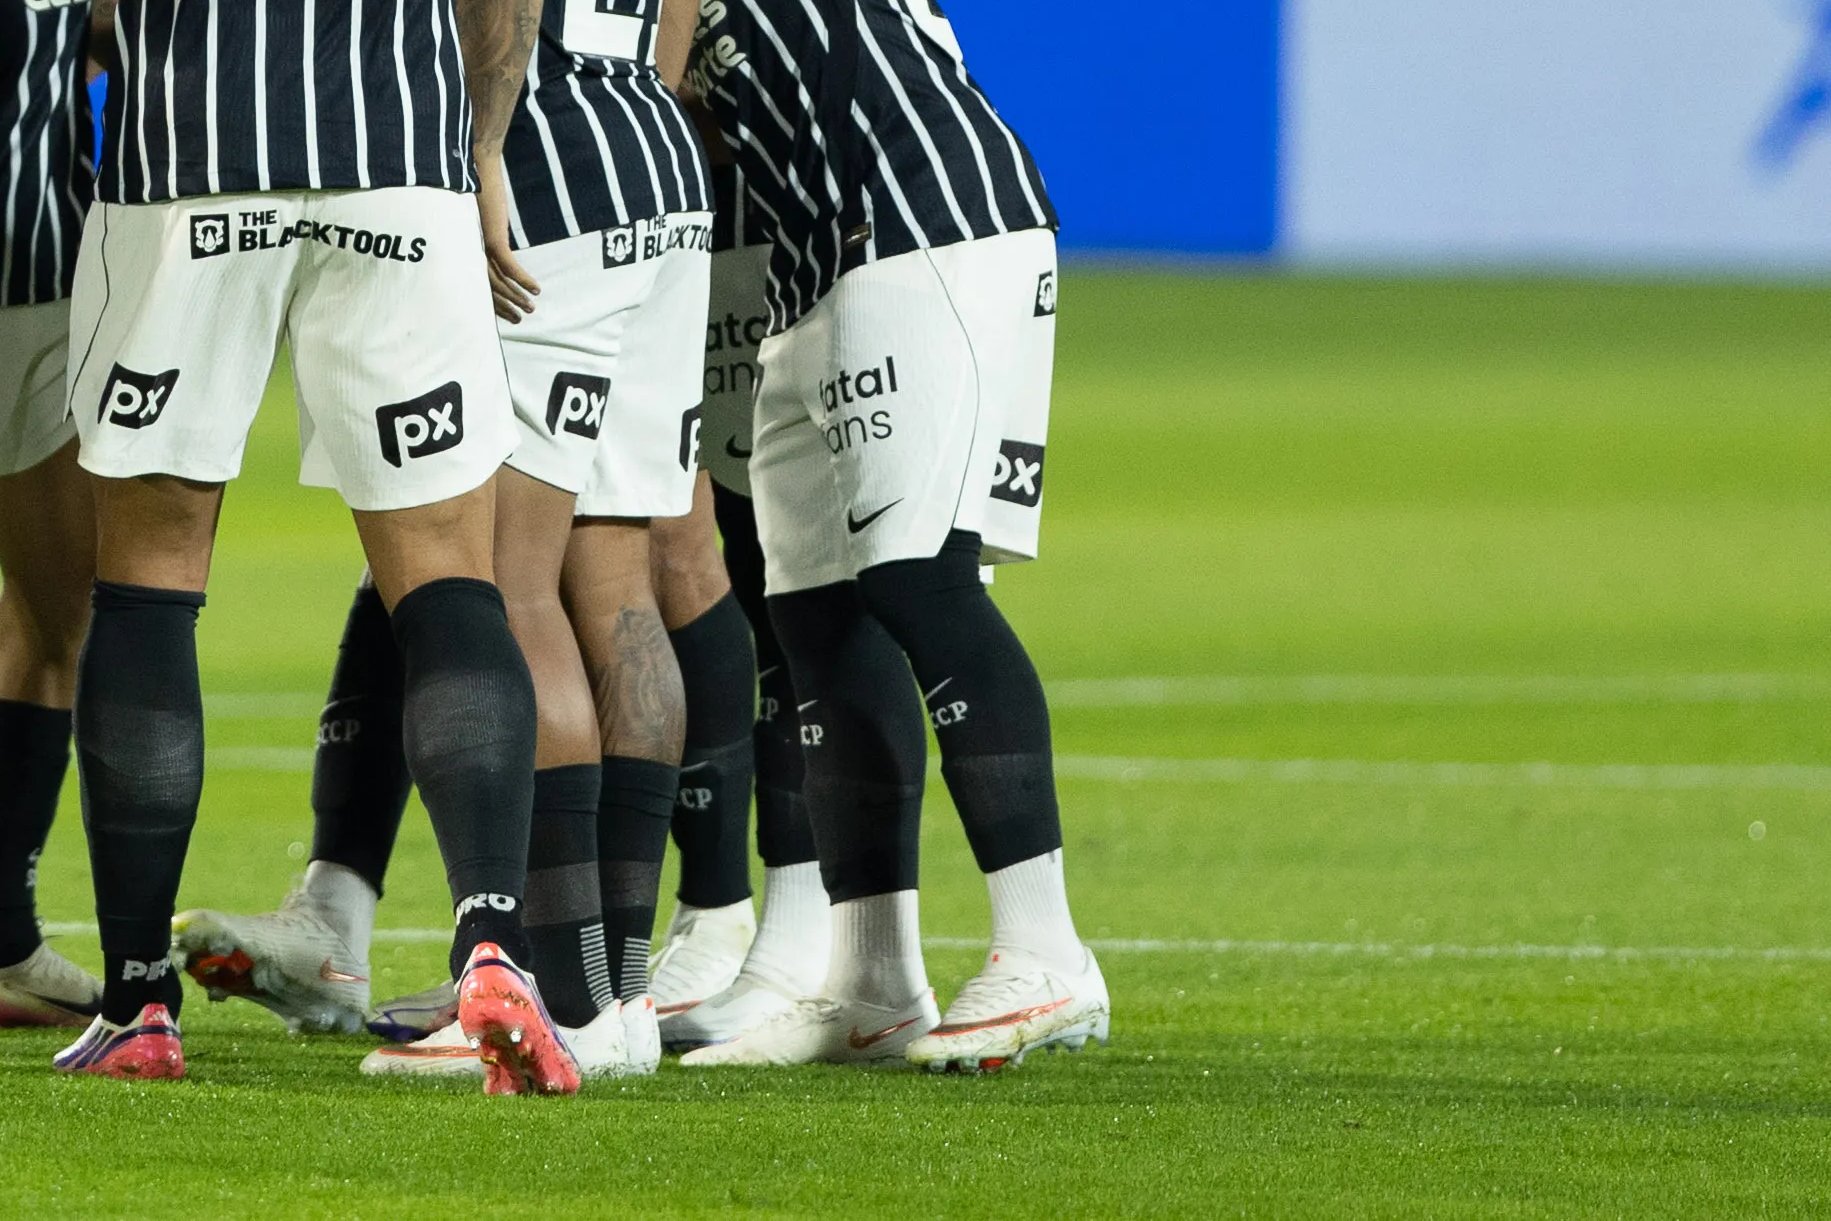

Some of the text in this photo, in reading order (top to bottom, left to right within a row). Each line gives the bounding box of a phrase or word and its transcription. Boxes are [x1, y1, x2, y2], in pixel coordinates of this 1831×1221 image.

[238, 209, 278, 227] THE
[238, 218, 428, 263] BLACKTOOLS
[106, 378, 166, 424] px
[553, 385, 606, 436] px
[394, 401, 458, 466] px
[820, 409, 893, 454] ans
[455, 892, 517, 927] PRO
